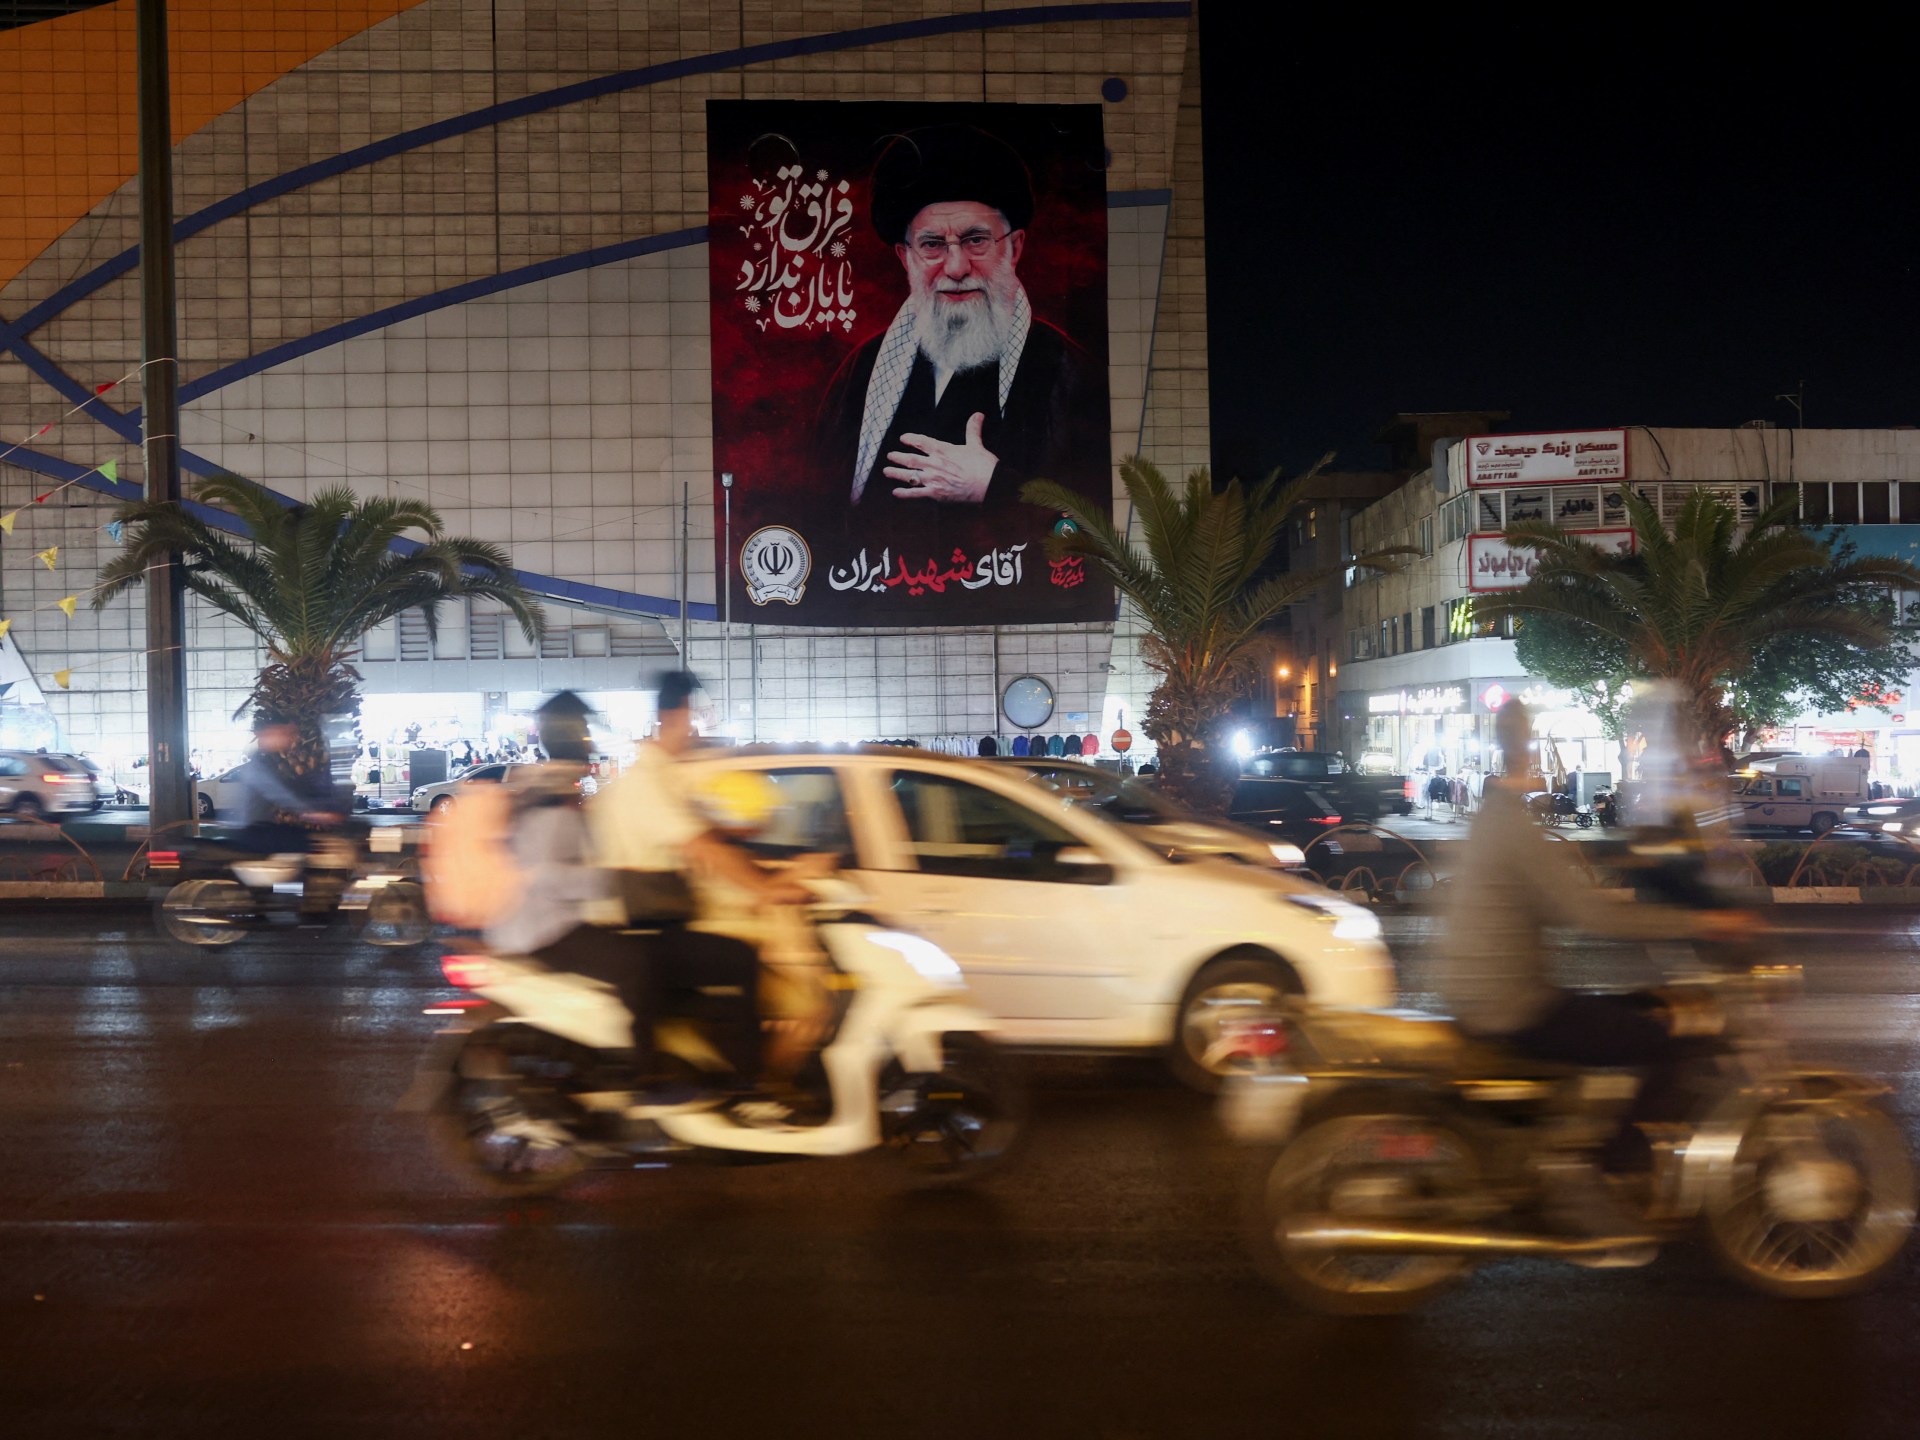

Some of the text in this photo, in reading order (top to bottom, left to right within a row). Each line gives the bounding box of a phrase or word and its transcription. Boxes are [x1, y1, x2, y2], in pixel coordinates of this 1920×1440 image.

[762, 165, 853, 257] فراق تو
[736, 241, 857, 331] پایان ندارد
[1494, 440, 1618, 458] مسکن بزرگ دیاموند
[828, 541, 1028, 596] آقای شهید ایران
